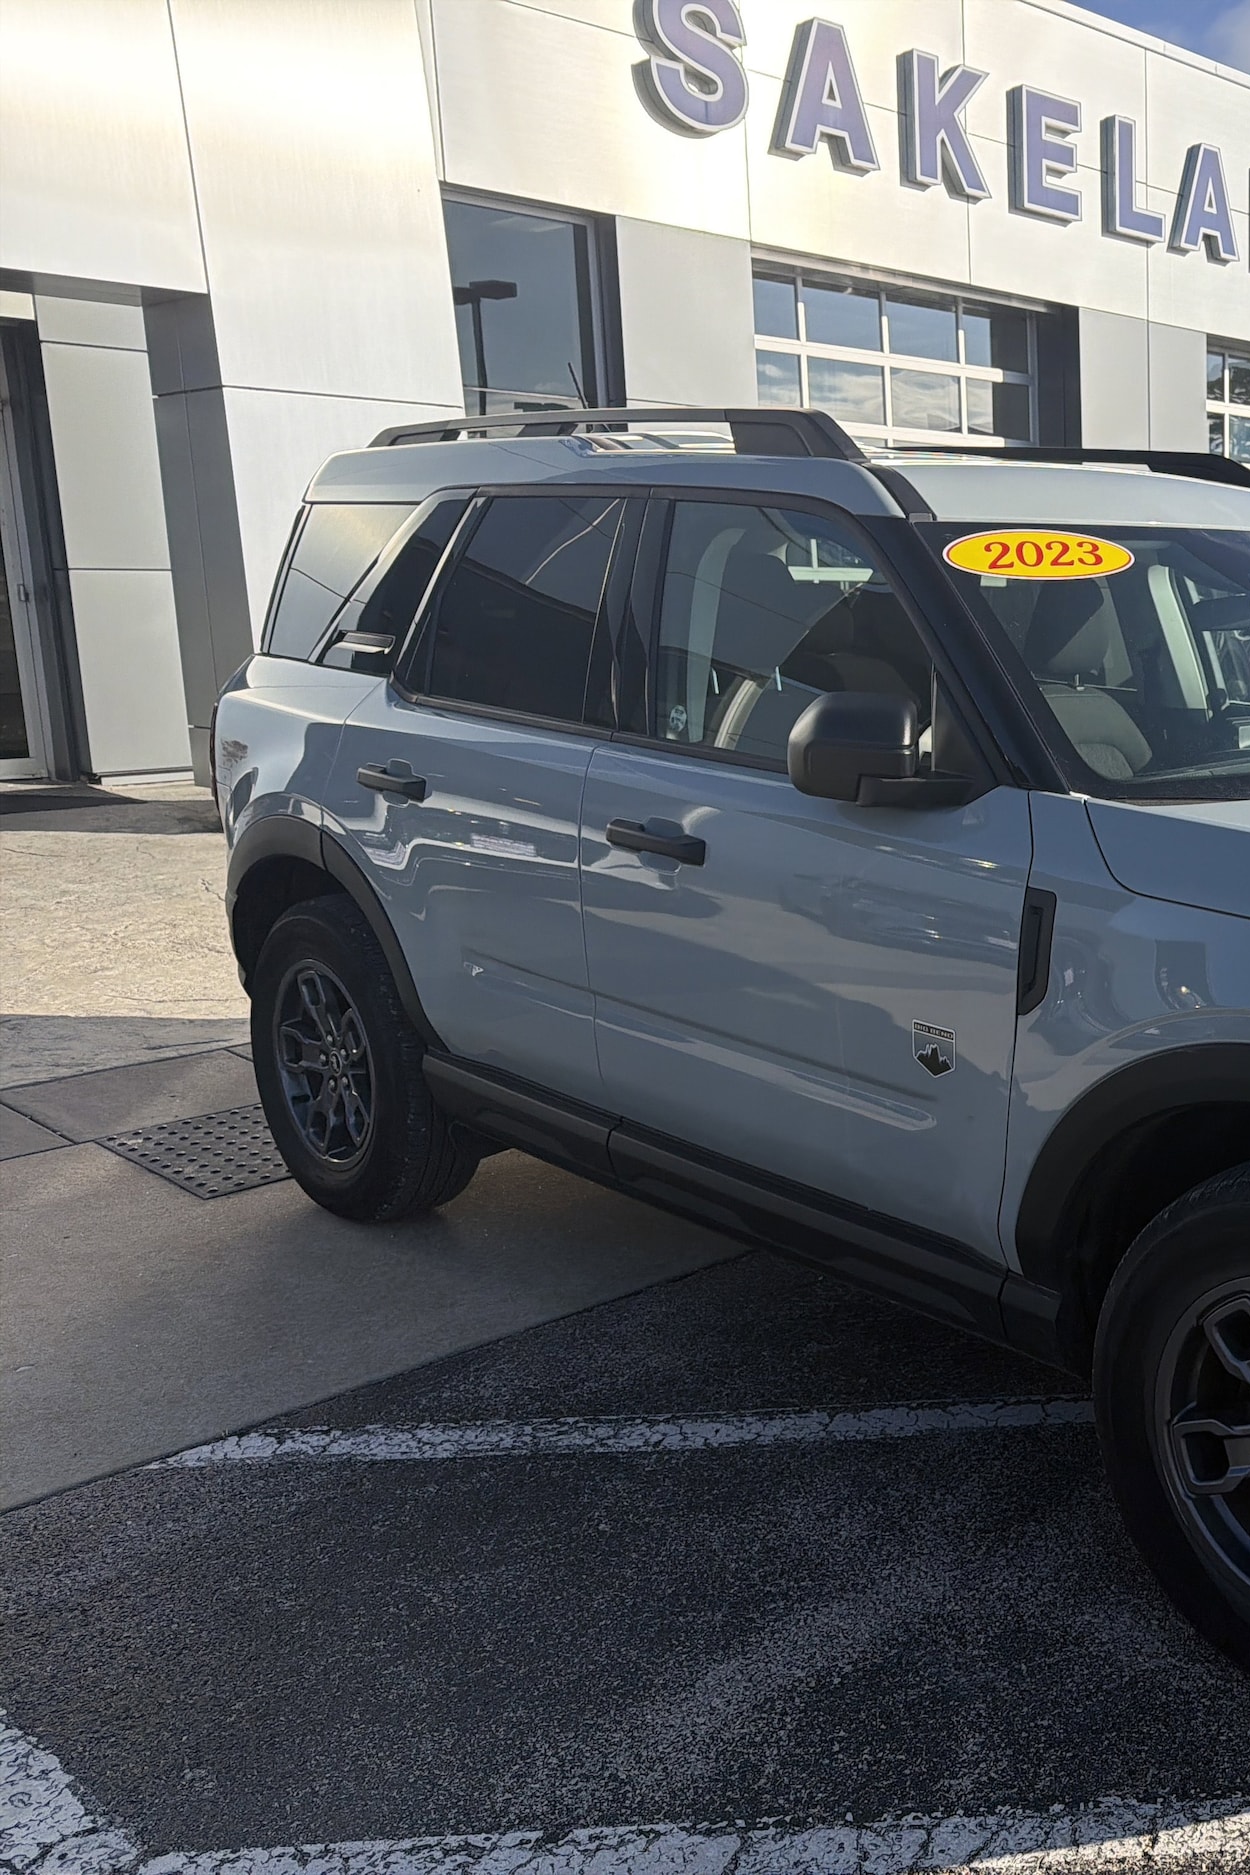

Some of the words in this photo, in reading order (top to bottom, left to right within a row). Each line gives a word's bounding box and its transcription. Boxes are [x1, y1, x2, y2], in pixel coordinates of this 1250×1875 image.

[984, 541, 1104, 570] 2023
[914, 1022, 929, 1033] BIG
[930, 1028, 954, 1040] BEND
